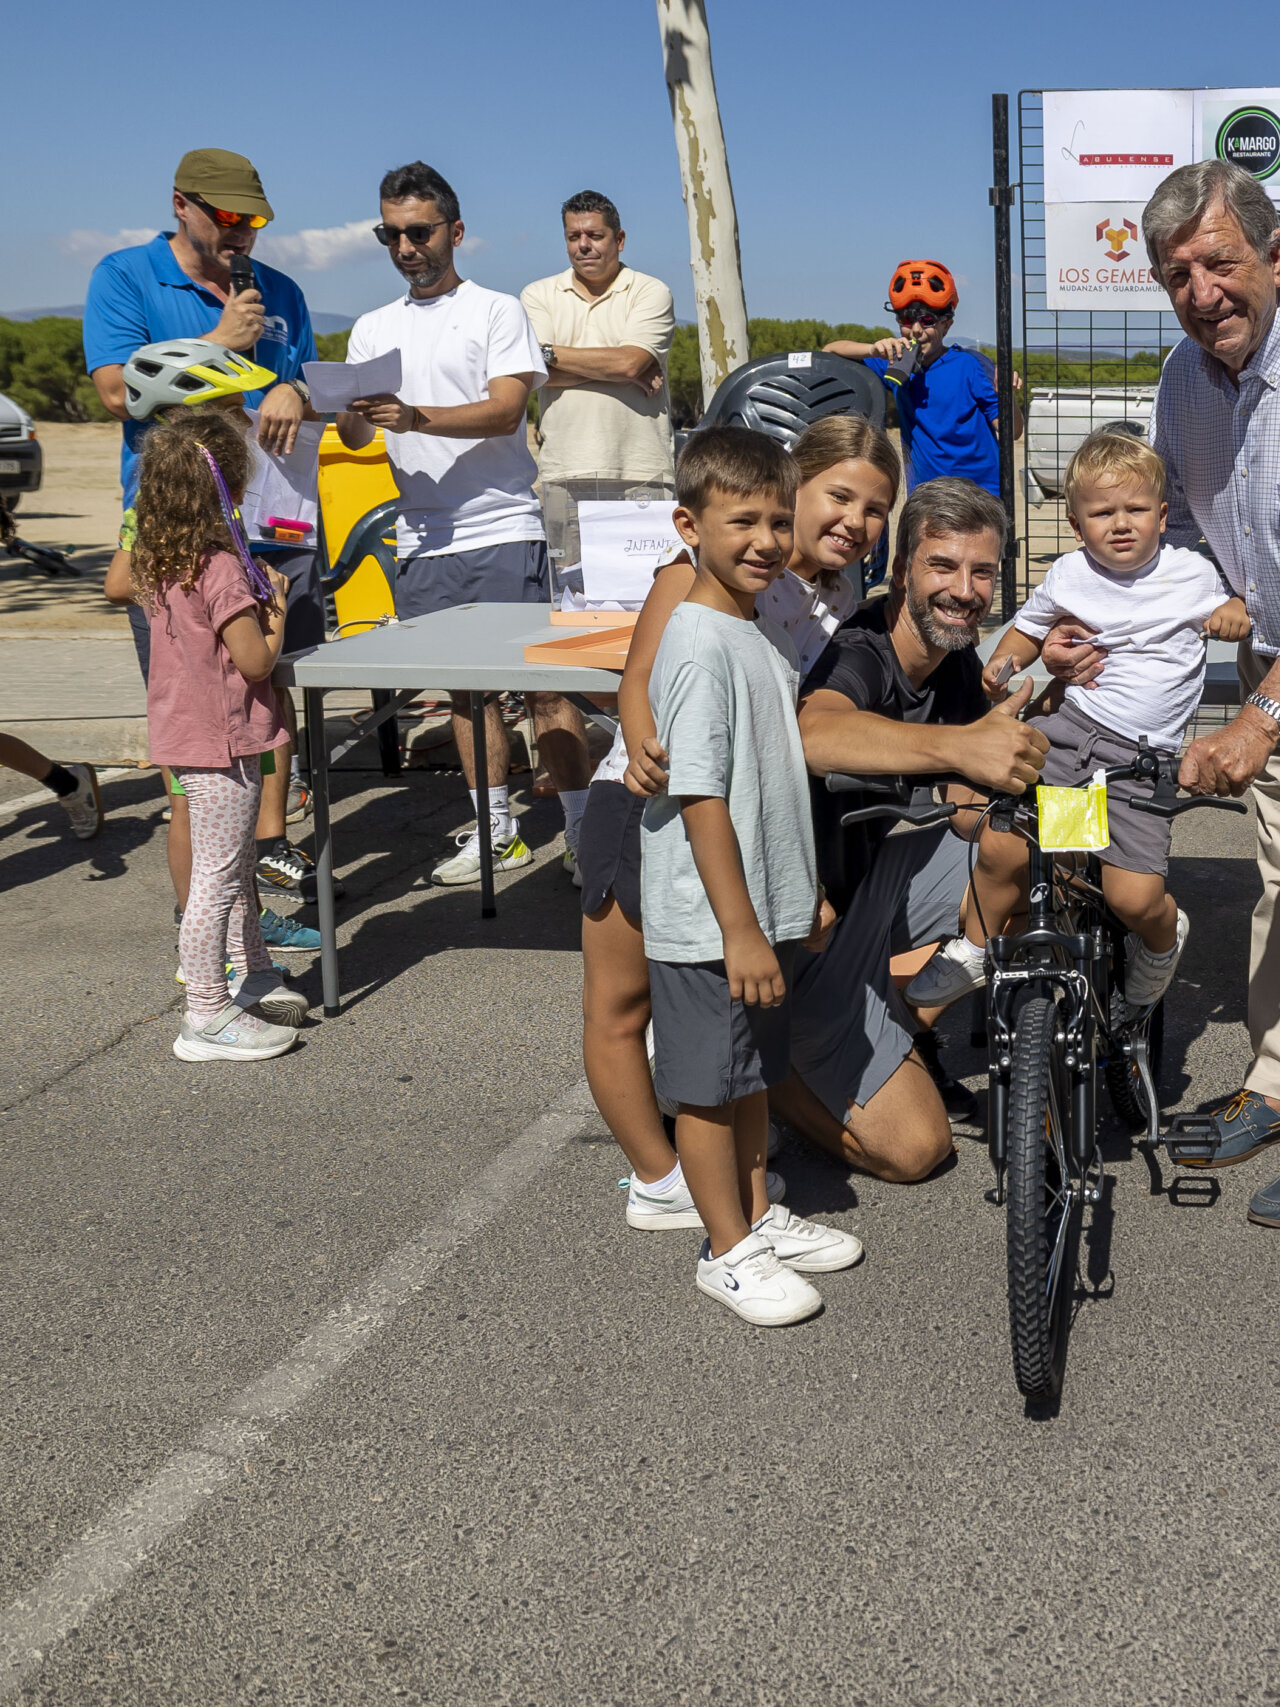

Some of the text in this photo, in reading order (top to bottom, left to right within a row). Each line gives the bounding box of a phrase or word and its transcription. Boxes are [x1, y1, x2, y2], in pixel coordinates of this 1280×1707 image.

[1228, 137, 1276, 151] KAMARGO
[1059, 268, 1153, 284] LOS GEMEL
